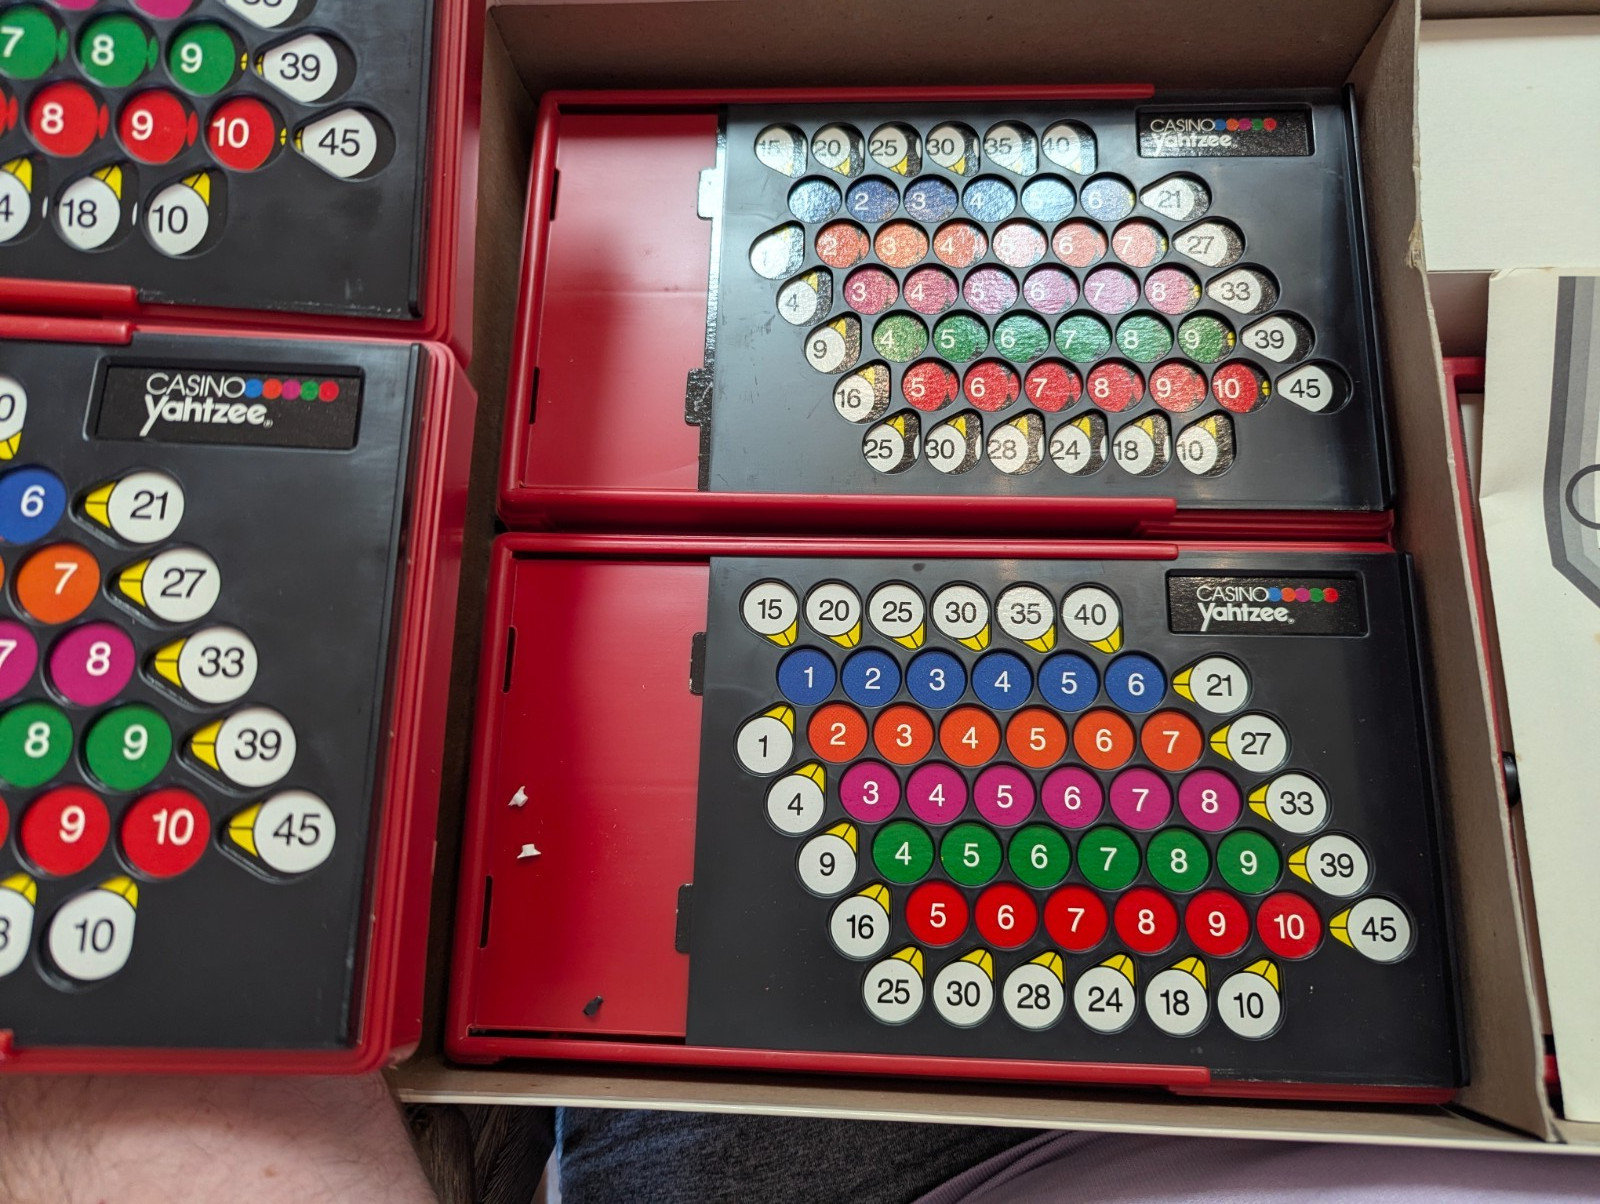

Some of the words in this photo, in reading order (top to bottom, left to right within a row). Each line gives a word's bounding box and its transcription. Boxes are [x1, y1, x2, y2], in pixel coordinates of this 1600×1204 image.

[1, 27, 24, 57] 7
[91, 34, 114, 66] 8
[180, 43, 203, 73] 9
[280, 52, 321, 81] 39
[40, 103, 64, 134] 8
[131, 110, 154, 141] 9
[212, 117, 250, 148] 10
[318, 127, 360, 157] 45
[1150, 119, 1216, 132] CASINO
[814, 140, 841, 157] 20
[871, 139, 897, 157] 25
[927, 138, 954, 156] 30
[984, 138, 1012, 155] 35
[62, 199, 97, 228] 18
[152, 206, 188, 234] 10
[855, 192, 869, 210] 2
[912, 192, 926, 210] 3
[970, 191, 984, 209] 4
[1089, 191, 1103, 209] 6
[1158, 191, 1181, 208] 21
[823, 238, 837, 256] 2
[881, 237, 896, 255] 3
[940, 237, 955, 255] 4
[1059, 236, 1073, 255] 6
[1119, 236, 1133, 255] 7
[1187, 236, 1214, 254] 27
[786, 294, 799, 312] 4
[852, 282, 867, 301] 3
[910, 281, 925, 301] 4
[972, 281, 985, 300] 5
[1030, 282, 1045, 301] 6
[1091, 283, 1105, 301] 7
[1152, 283, 1166, 301] 8
[1221, 282, 1250, 301] 33
[813, 339, 827, 359] 9
[879, 328, 894, 348] 4
[940, 329, 955, 348] 5
[1001, 329, 1015, 349] 6
[1062, 329, 1077, 349] 7
[1124, 329, 1139, 349] 8
[1184, 330, 1199, 349] 9
[1254, 330, 1284, 349] 39
[146, 372, 245, 399] CASINO
[837, 388, 861, 408] 16
[909, 377, 925, 397] 5
[970, 377, 985, 397] 6
[1032, 378, 1047, 398] 7
[1094, 378, 1110, 398] 8
[1156, 378, 1171, 398] 9
[1214, 379, 1240, 398] 10
[1290, 379, 1320, 398] 45
[863, 439, 893, 459] 25
[926, 439, 955, 459] 30
[989, 439, 1017, 460] 28
[1051, 440, 1080, 461] 24
[1114, 440, 1138, 461] 18
[1177, 440, 1203, 462] 10
[20, 485, 45, 518] 6
[129, 491, 168, 520] 21
[54, 562, 78, 594] 7
[160, 568, 207, 598] 27
[1196, 585, 1268, 602] CASINO
[757, 599, 782, 619] 15
[818, 599, 849, 621] 20
[882, 601, 912, 622] 25
[945, 601, 976, 623] 30
[1010, 603, 1042, 624] 35
[1074, 604, 1106, 626] 40
[86, 642, 111, 676] 8
[198, 647, 244, 678] 33
[804, 667, 814, 688] 1
[865, 668, 881, 689] 2
[929, 669, 945, 691] 3
[994, 671, 1011, 692] 4
[1061, 672, 1077, 694] 5
[1128, 673, 1145, 696] 6
[1206, 674, 1232, 696] 21
[24, 722, 50, 758] 8
[122, 725, 148, 760] 9
[234, 729, 282, 761] 39
[759, 735, 768, 757] 1
[830, 723, 846, 745] 2
[896, 724, 912, 747] 3
[961, 726, 978, 748] 4
[1029, 728, 1046, 750] 5
[1095, 729, 1113, 752] 6
[1163, 731, 1180, 754] 7
[1240, 732, 1271, 755] 27
[787, 793, 803, 815] 4
[862, 781, 879, 804] 3
[929, 784, 945, 807] 4
[996, 785, 1013, 808] 5
[1064, 786, 1081, 810] 6
[1132, 788, 1149, 811] 7
[1201, 790, 1219, 814] 8
[1280, 791, 1314, 815] 33
[59, 806, 85, 843] 9
[152, 808, 194, 846] 10
[272, 813, 321, 846] 45
[819, 852, 835, 876] 9
[895, 842, 912, 865] 4
[963, 843, 980, 867] 5
[1030, 845, 1048, 869] 6
[1100, 847, 1118, 871] 7
[1170, 849, 1188, 873] 8
[1239, 850, 1257, 875] 9
[1319, 853, 1354, 877] 39
[74, 918, 115, 952] 10
[847, 915, 874, 939] 16
[930, 903, 946, 928] 5
[997, 905, 1015, 929] 6
[1067, 908, 1085, 932] 7
[1138, 909, 1156, 934] 8
[1208, 911, 1226, 936] 9
[1274, 914, 1305, 939] 10
[1361, 917, 1397, 942] 45
[877, 978, 910, 1004] 25
[946, 981, 980, 1006] 30
[1017, 983, 1050, 1009] 28
[1087, 986, 1123, 1012] 24
[1160, 989, 1189, 1015] 18
[1233, 992, 1263, 1018] 10
